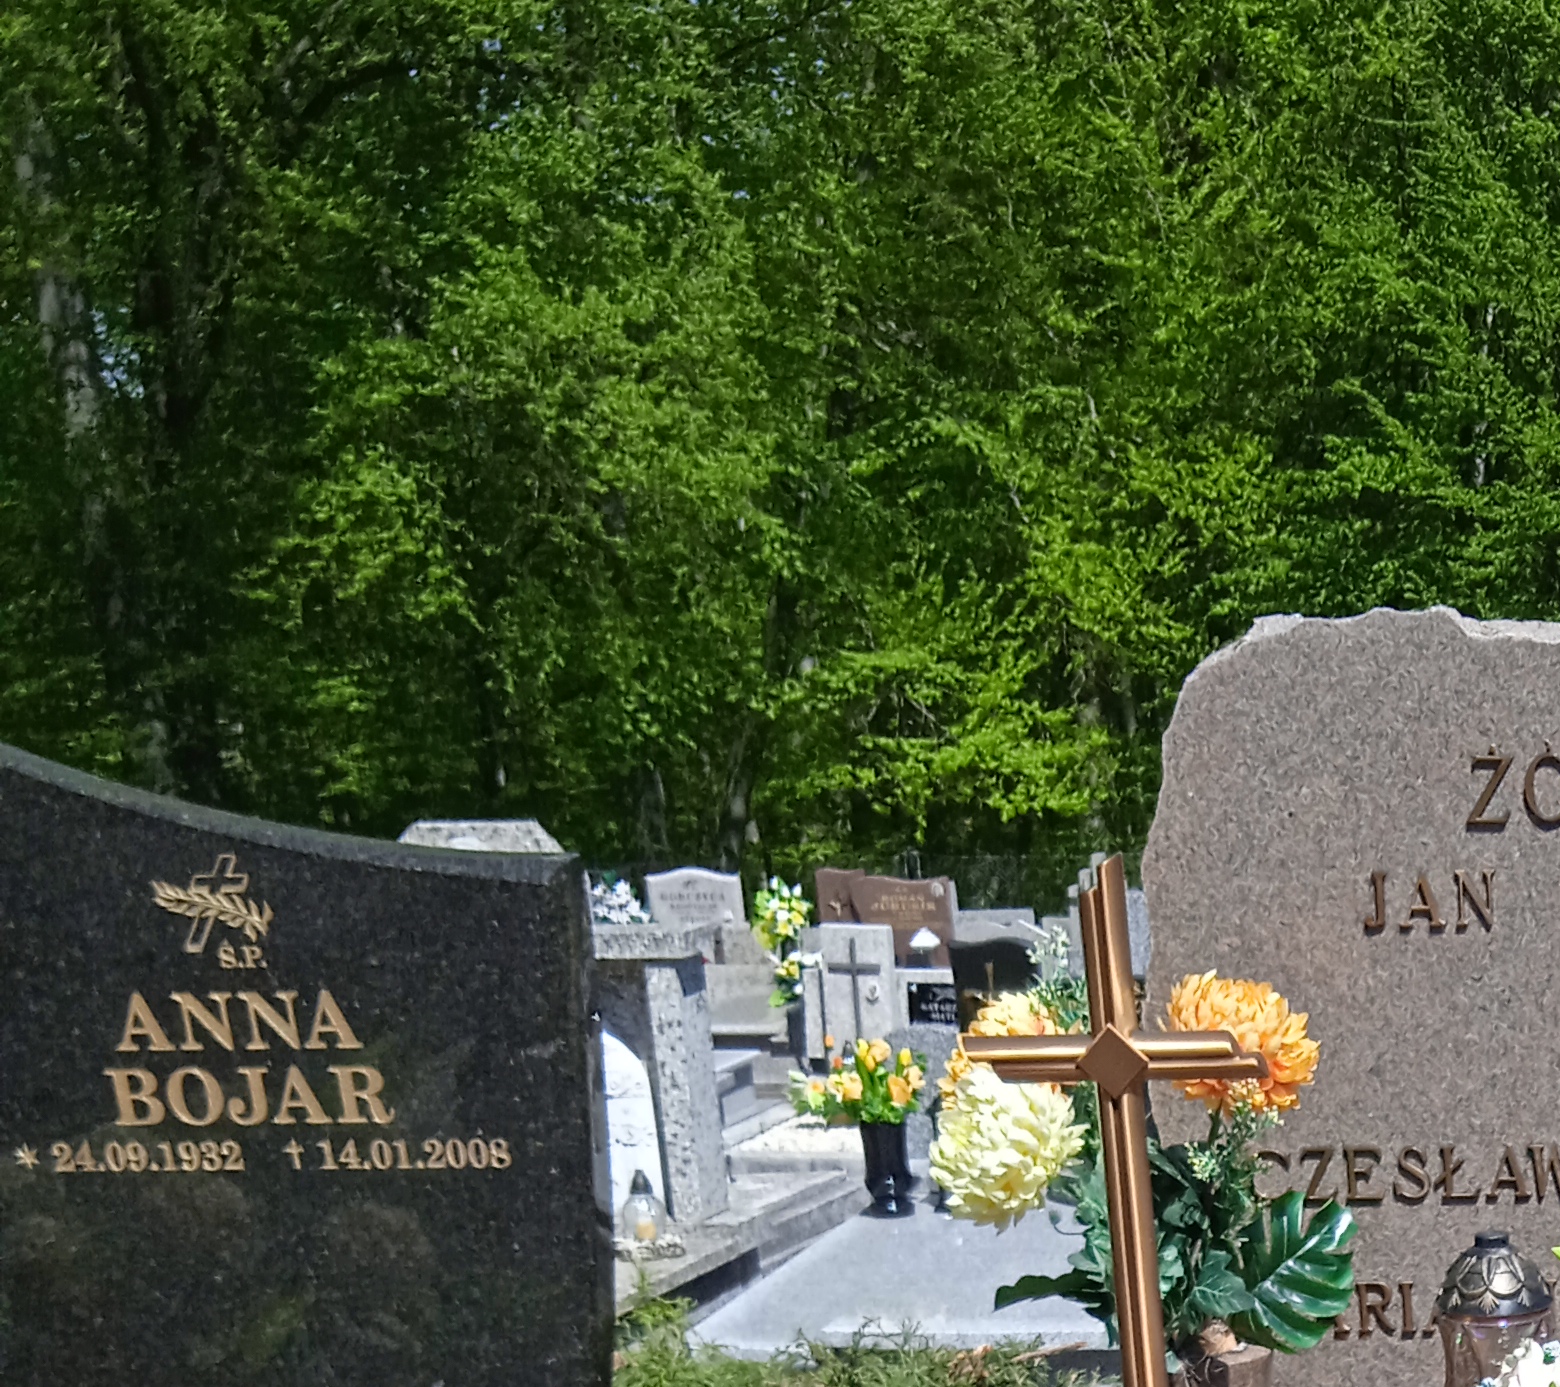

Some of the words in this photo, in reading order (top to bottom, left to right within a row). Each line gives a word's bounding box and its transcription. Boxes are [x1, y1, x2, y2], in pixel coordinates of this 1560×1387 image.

[1363, 868, 1496, 934] JAN
[115, 988, 364, 1052] ANNA
[104, 1063, 396, 1127] BOJAR
[50, 1138, 246, 1173] 24.09.1932
[316, 1137, 514, 1171] 14.01.2008
